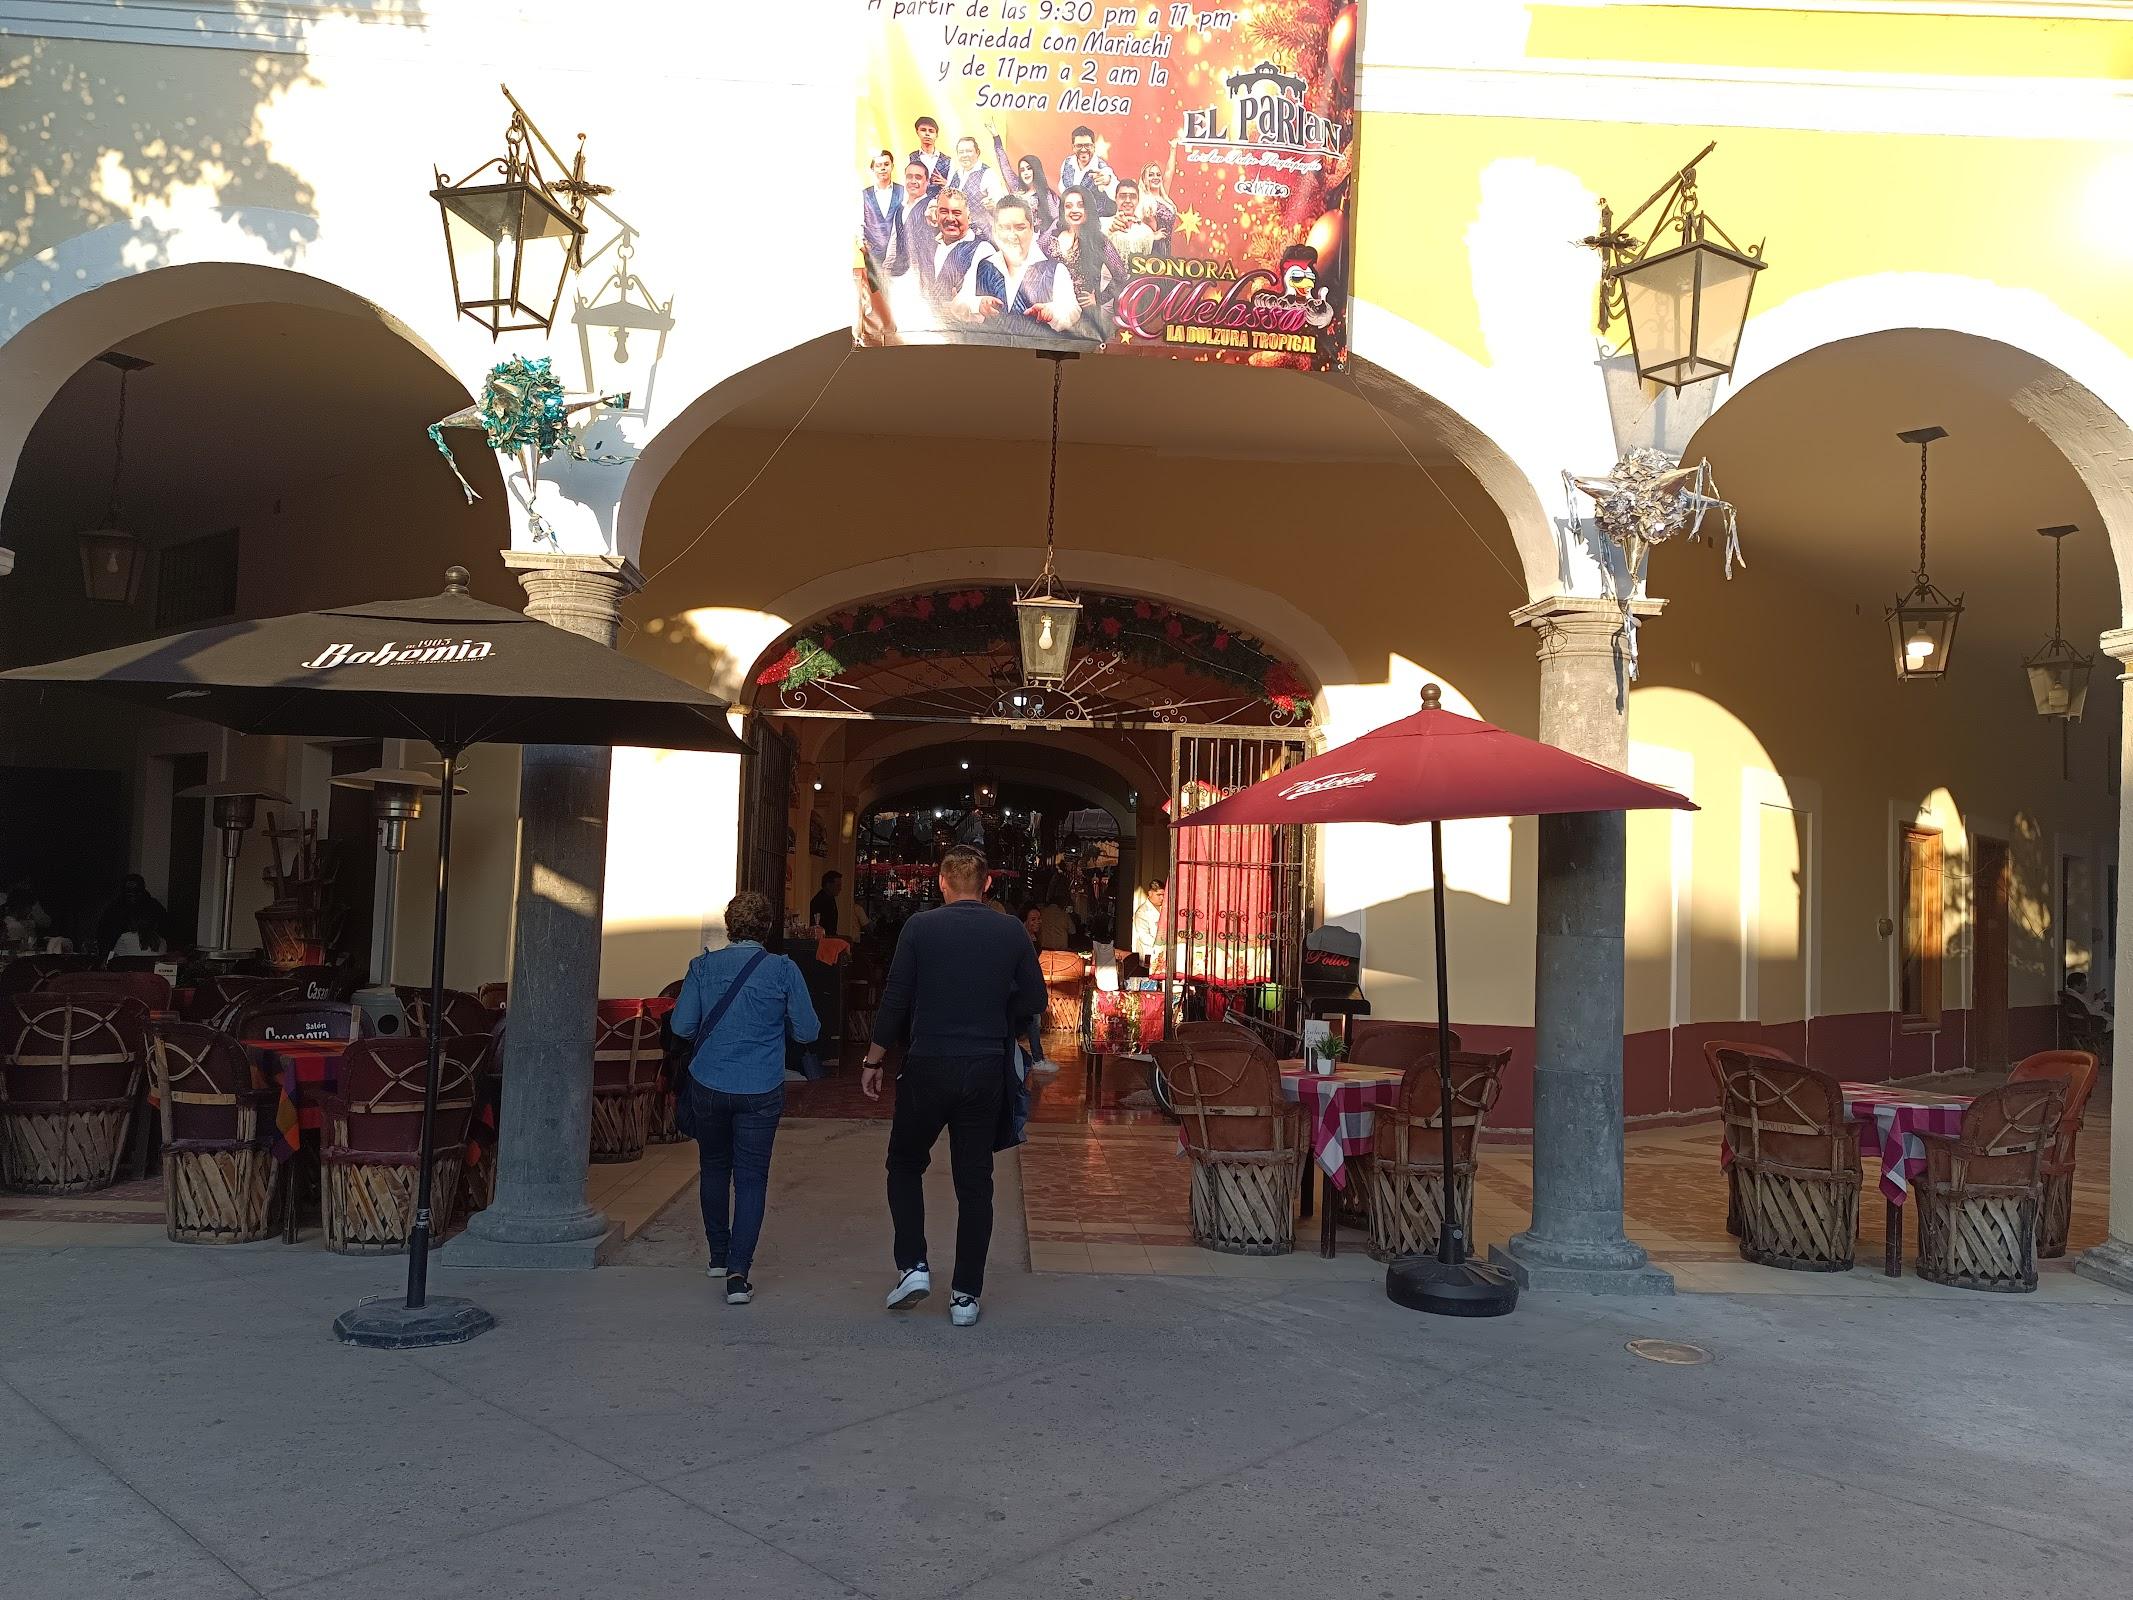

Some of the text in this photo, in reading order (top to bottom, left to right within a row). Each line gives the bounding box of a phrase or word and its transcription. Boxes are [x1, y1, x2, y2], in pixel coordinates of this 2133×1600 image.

[892, 0, 956, 20] partir
[965, 0, 990, 18] de
[1000, 1, 1028, 20] las
[1038, 0, 1093, 22] 9:30
[1103, 7, 1137, 29] pm
[1147, 9, 1159, 25] a
[1169, 4, 1189, 27] 11
[943, 24, 1172, 57] Variedad con Mariachi
[937, 53, 1168, 86] y de 11pm a 2 am la
[975, 84, 1132, 114] Sonora Melosa
[1185, 107, 1228, 140] EL
[1131, 256, 1237, 281] SONORA
[1166, 324, 1317, 354] LA DULZURA TROPICAL
[301, 639, 494, 669] Bohemia
[305, 1022, 326, 1030] Salón
